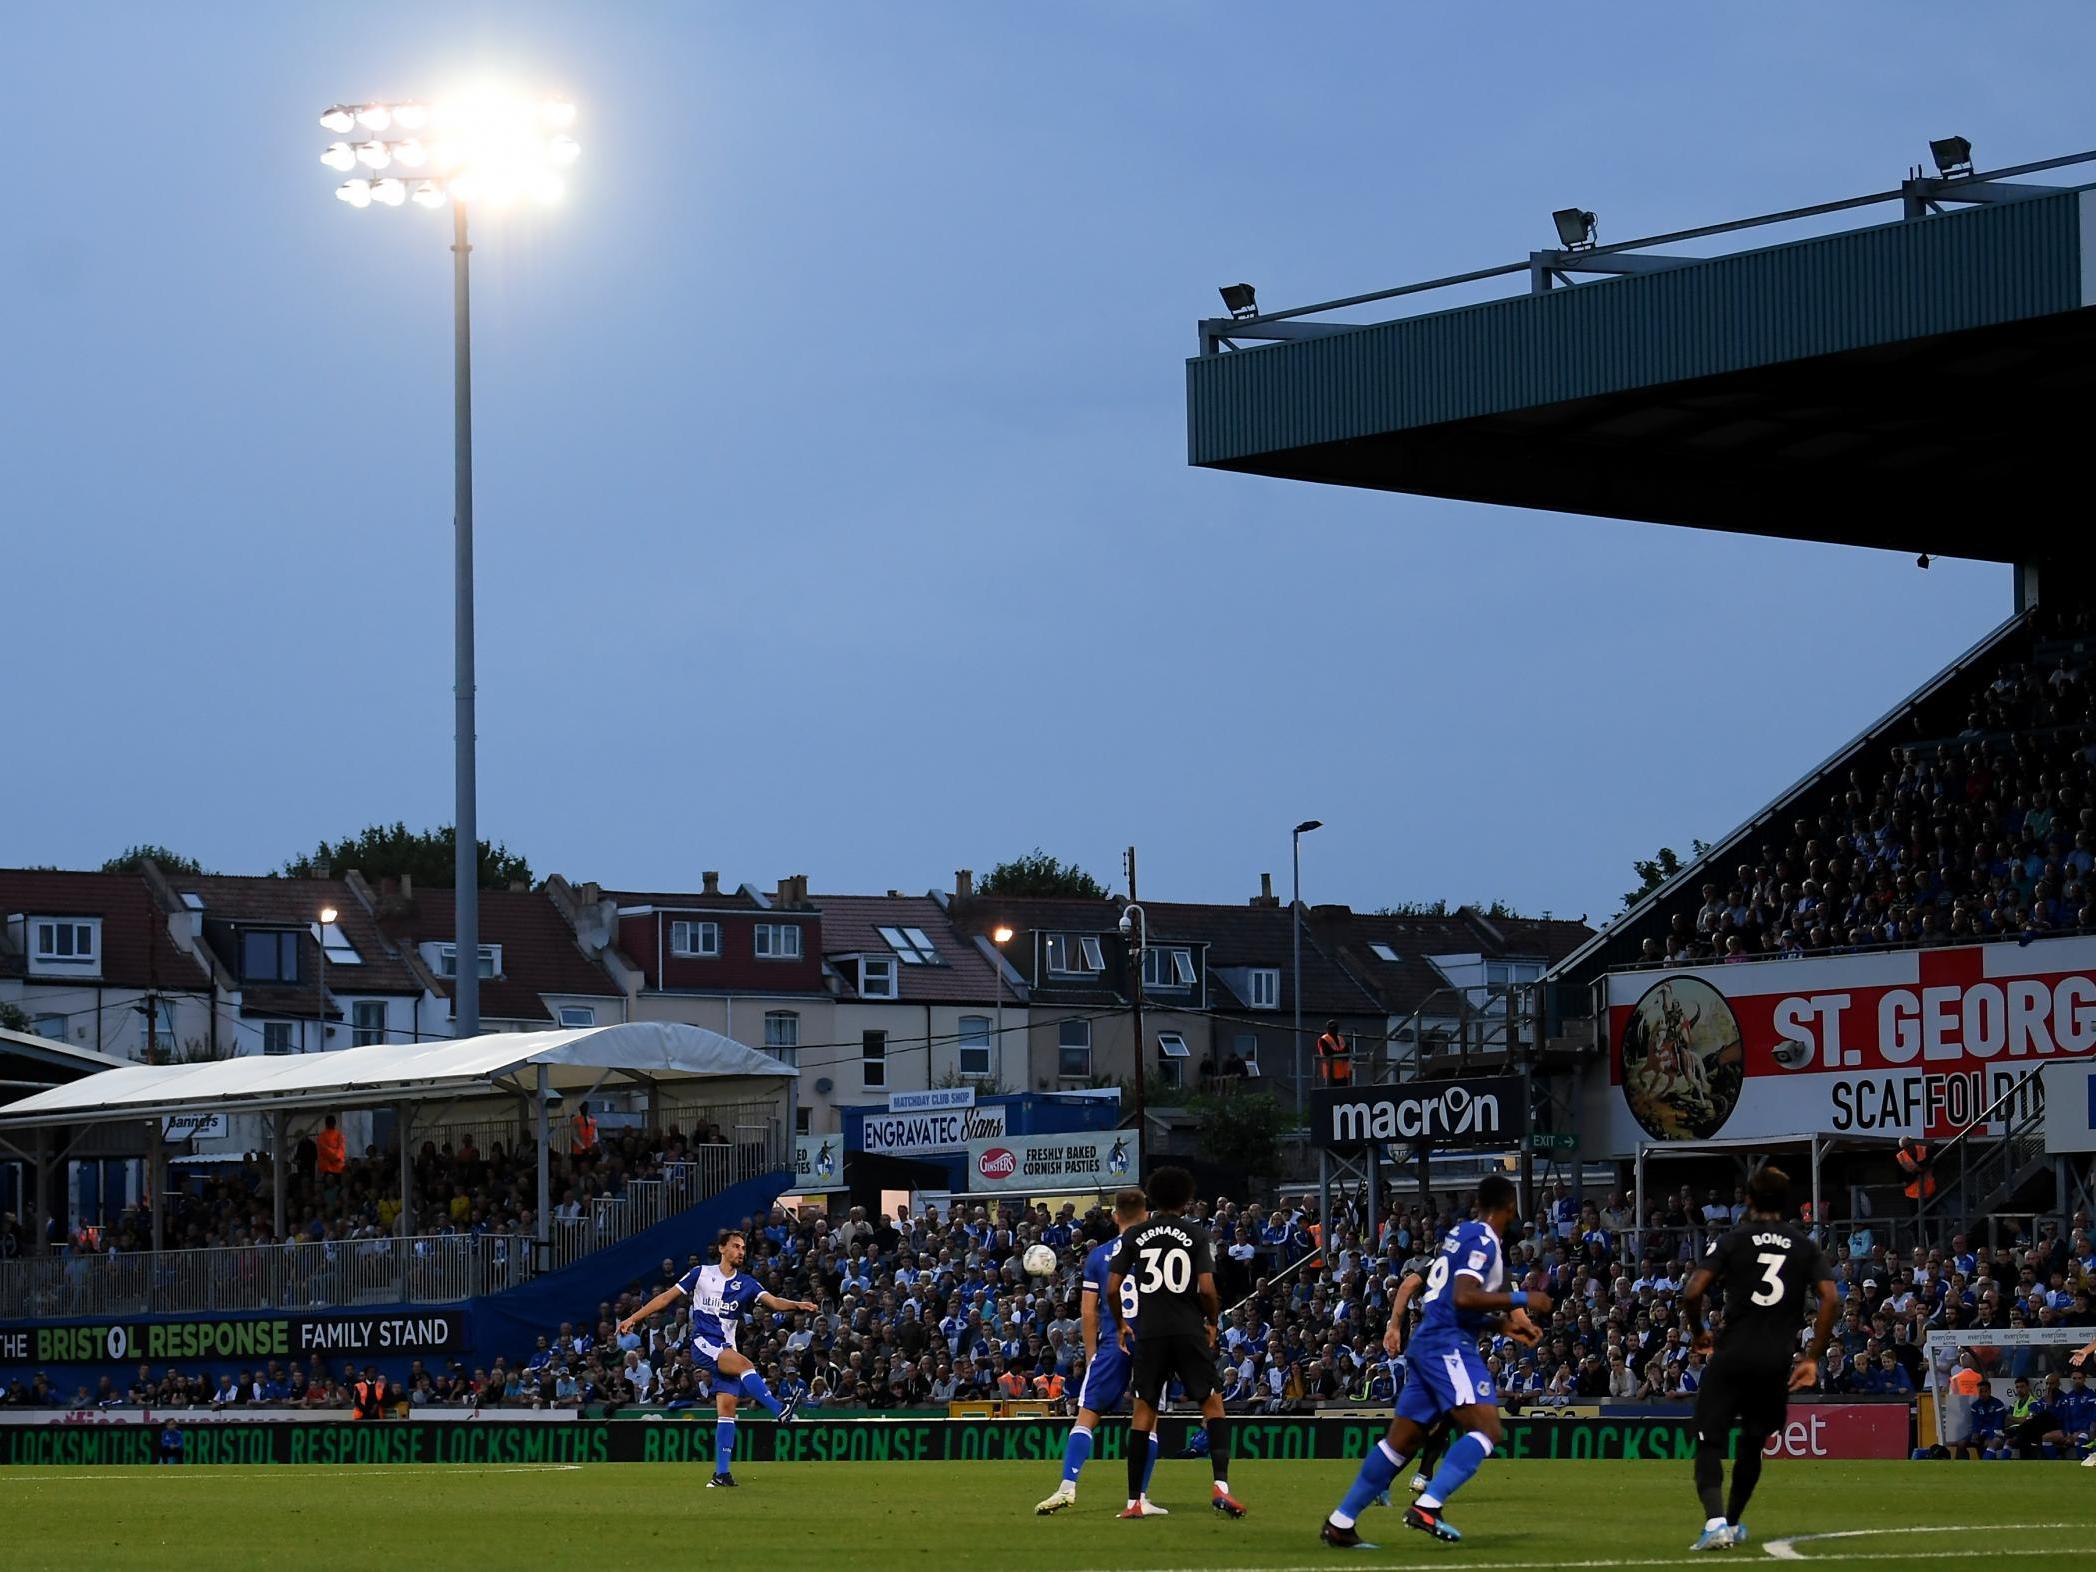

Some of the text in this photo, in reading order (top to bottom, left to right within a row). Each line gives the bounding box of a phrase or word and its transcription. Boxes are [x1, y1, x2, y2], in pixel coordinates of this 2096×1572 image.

[1772, 976, 2096, 1070] ST. GEORG
[893, 1092, 970, 1108] MATCHDAY CLUB SHOP
[1332, 1086, 1499, 1141] macron
[864, 1117, 958, 1149] ENGRAVATEC
[1533, 1135, 1556, 1147] EXIT
[1023, 1159, 1100, 1176] CORNISH PASTIES
[1026, 1146, 1097, 1162] FRESHLY BAKED
[1135, 1226, 1193, 1247] BERNARDO
[1752, 1232, 1792, 1249] BONG
[1139, 1248, 1191, 1293] 30
[1423, 1255, 1450, 1304] 9
[1750, 1252, 1787, 1307] 3
[38, 1325, 142, 1361] BRISTOL
[149, 1320, 289, 1358] RESPONSE
[302, 1322, 373, 1349] FAMILY
[379, 1318, 449, 1347] STAND
[11, 1430, 152, 1464] LOCKSMITHS
[183, 1427, 609, 1464] BRISTOL RESPONSE LOCKSMITHS
[775, 1427, 931, 1462] RESPONSE
[944, 1425, 1131, 1461] LOCKSMTH
[1185, 1425, 1315, 1460] BISTOL
